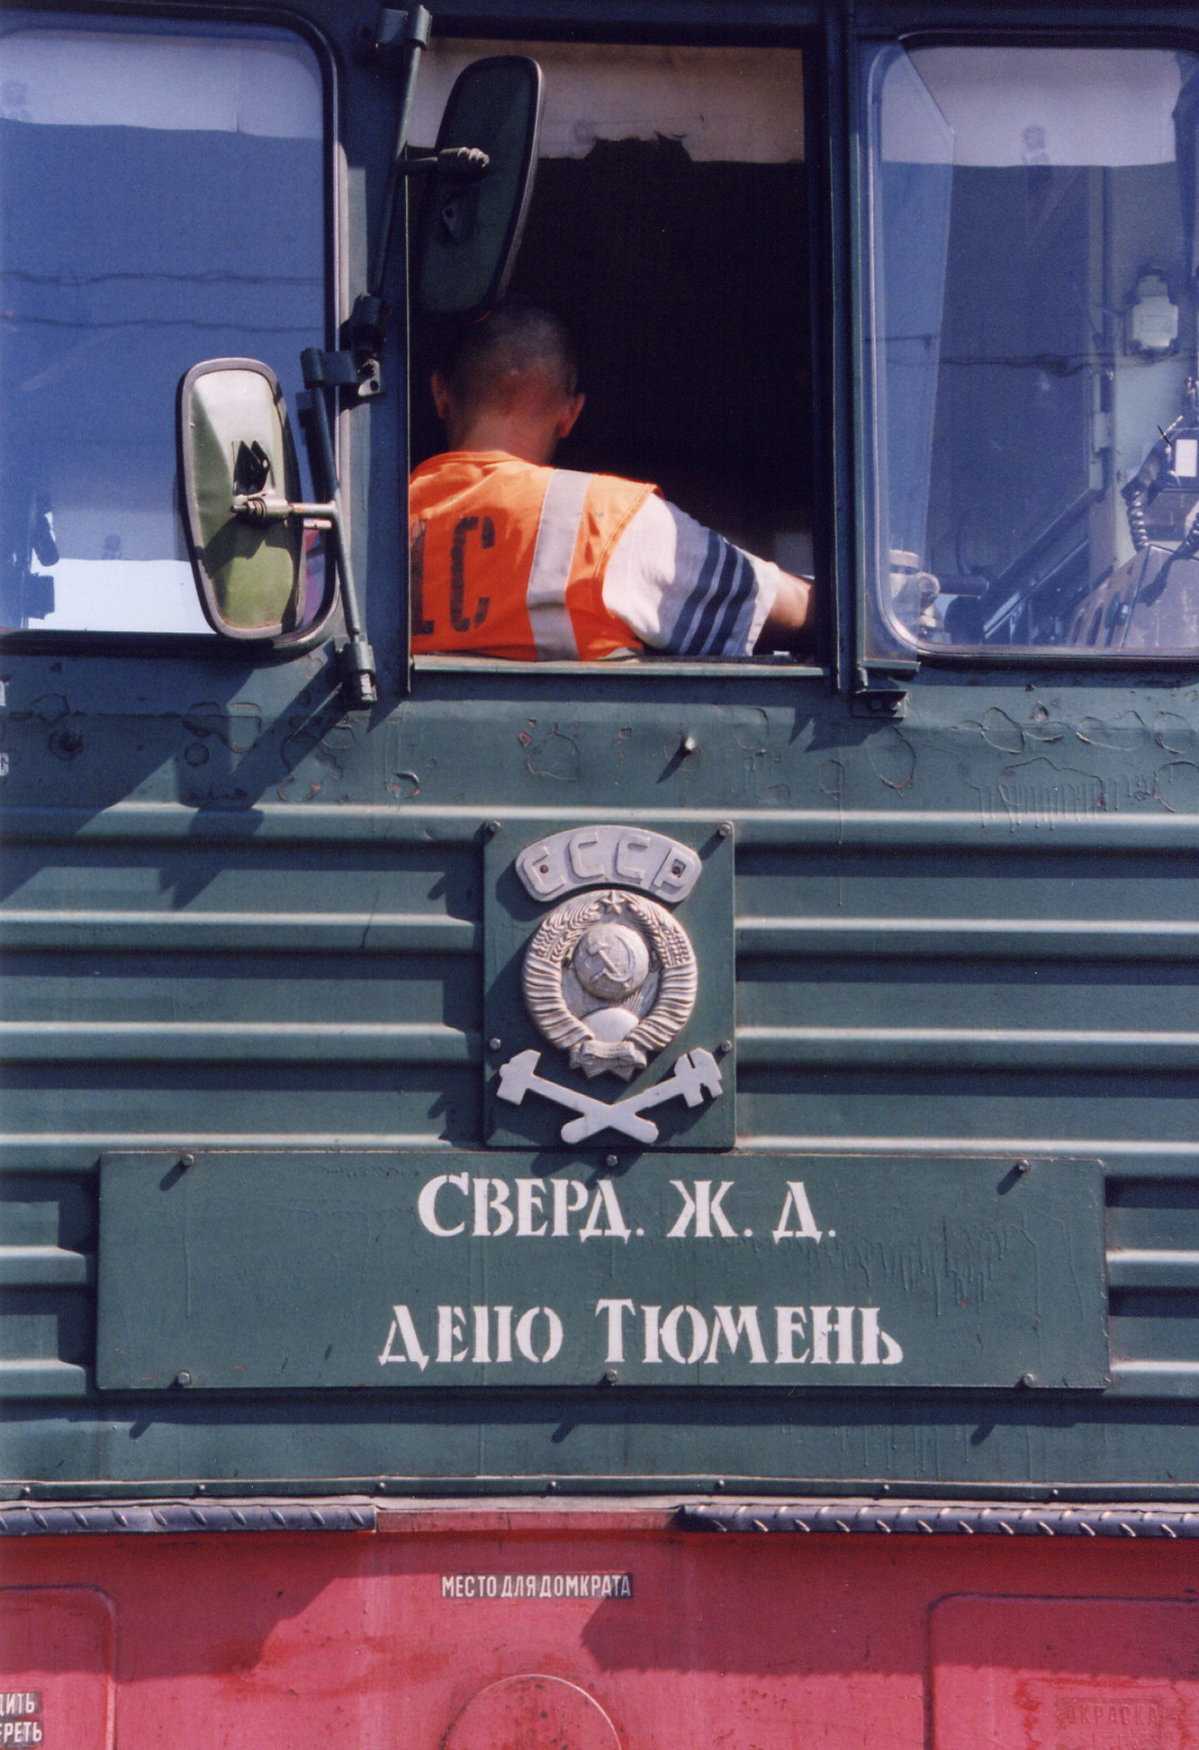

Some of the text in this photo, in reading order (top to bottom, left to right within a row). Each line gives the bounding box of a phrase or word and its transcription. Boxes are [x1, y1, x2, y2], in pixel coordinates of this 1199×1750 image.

[521, 831, 693, 896] СССР
[417, 1171, 836, 1244] СВЕРД. Ж. Д.
[378, 1298, 904, 1372] ДЕПО ТЮМЕНЬ
[441, 1575, 632, 1598] МЕСТО ДЛЯ ДОМКРАТА
[0, 1721, 43, 1744] РЕТЬ
